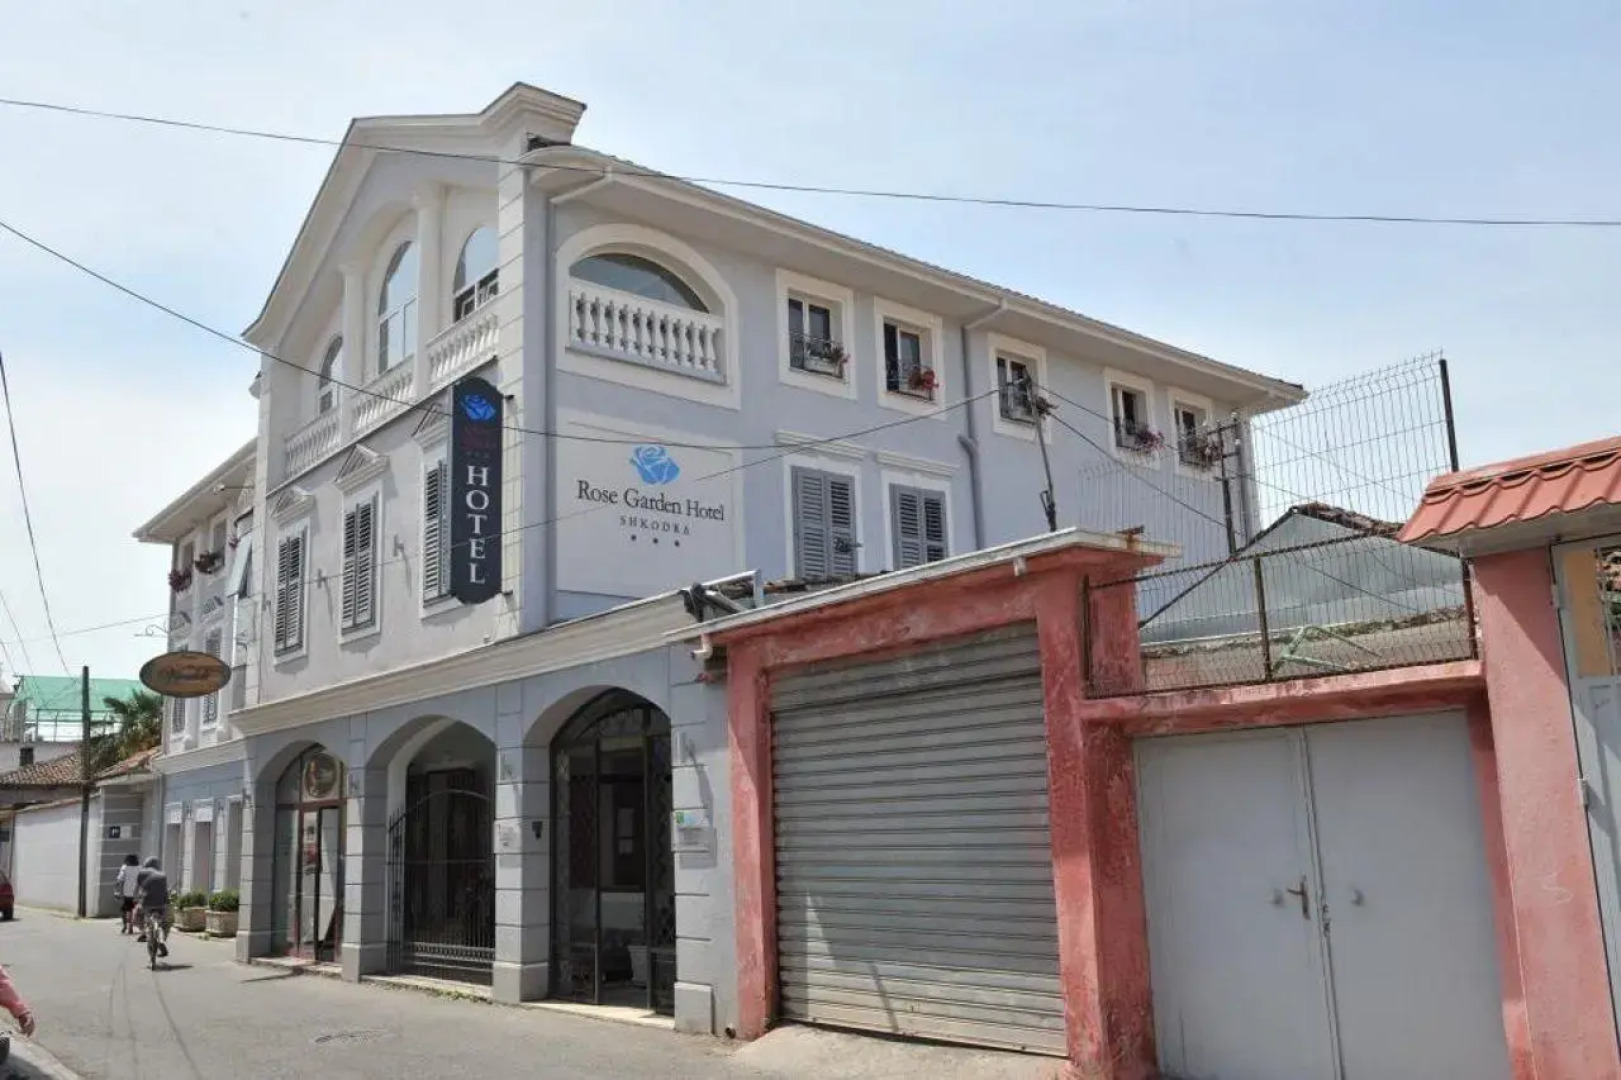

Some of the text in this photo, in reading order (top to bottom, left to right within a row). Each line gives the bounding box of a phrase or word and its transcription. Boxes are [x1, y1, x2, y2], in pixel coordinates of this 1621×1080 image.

[465, 465, 490, 584] HOTEL
[577, 480, 725, 521] Rose Garden Hotel
